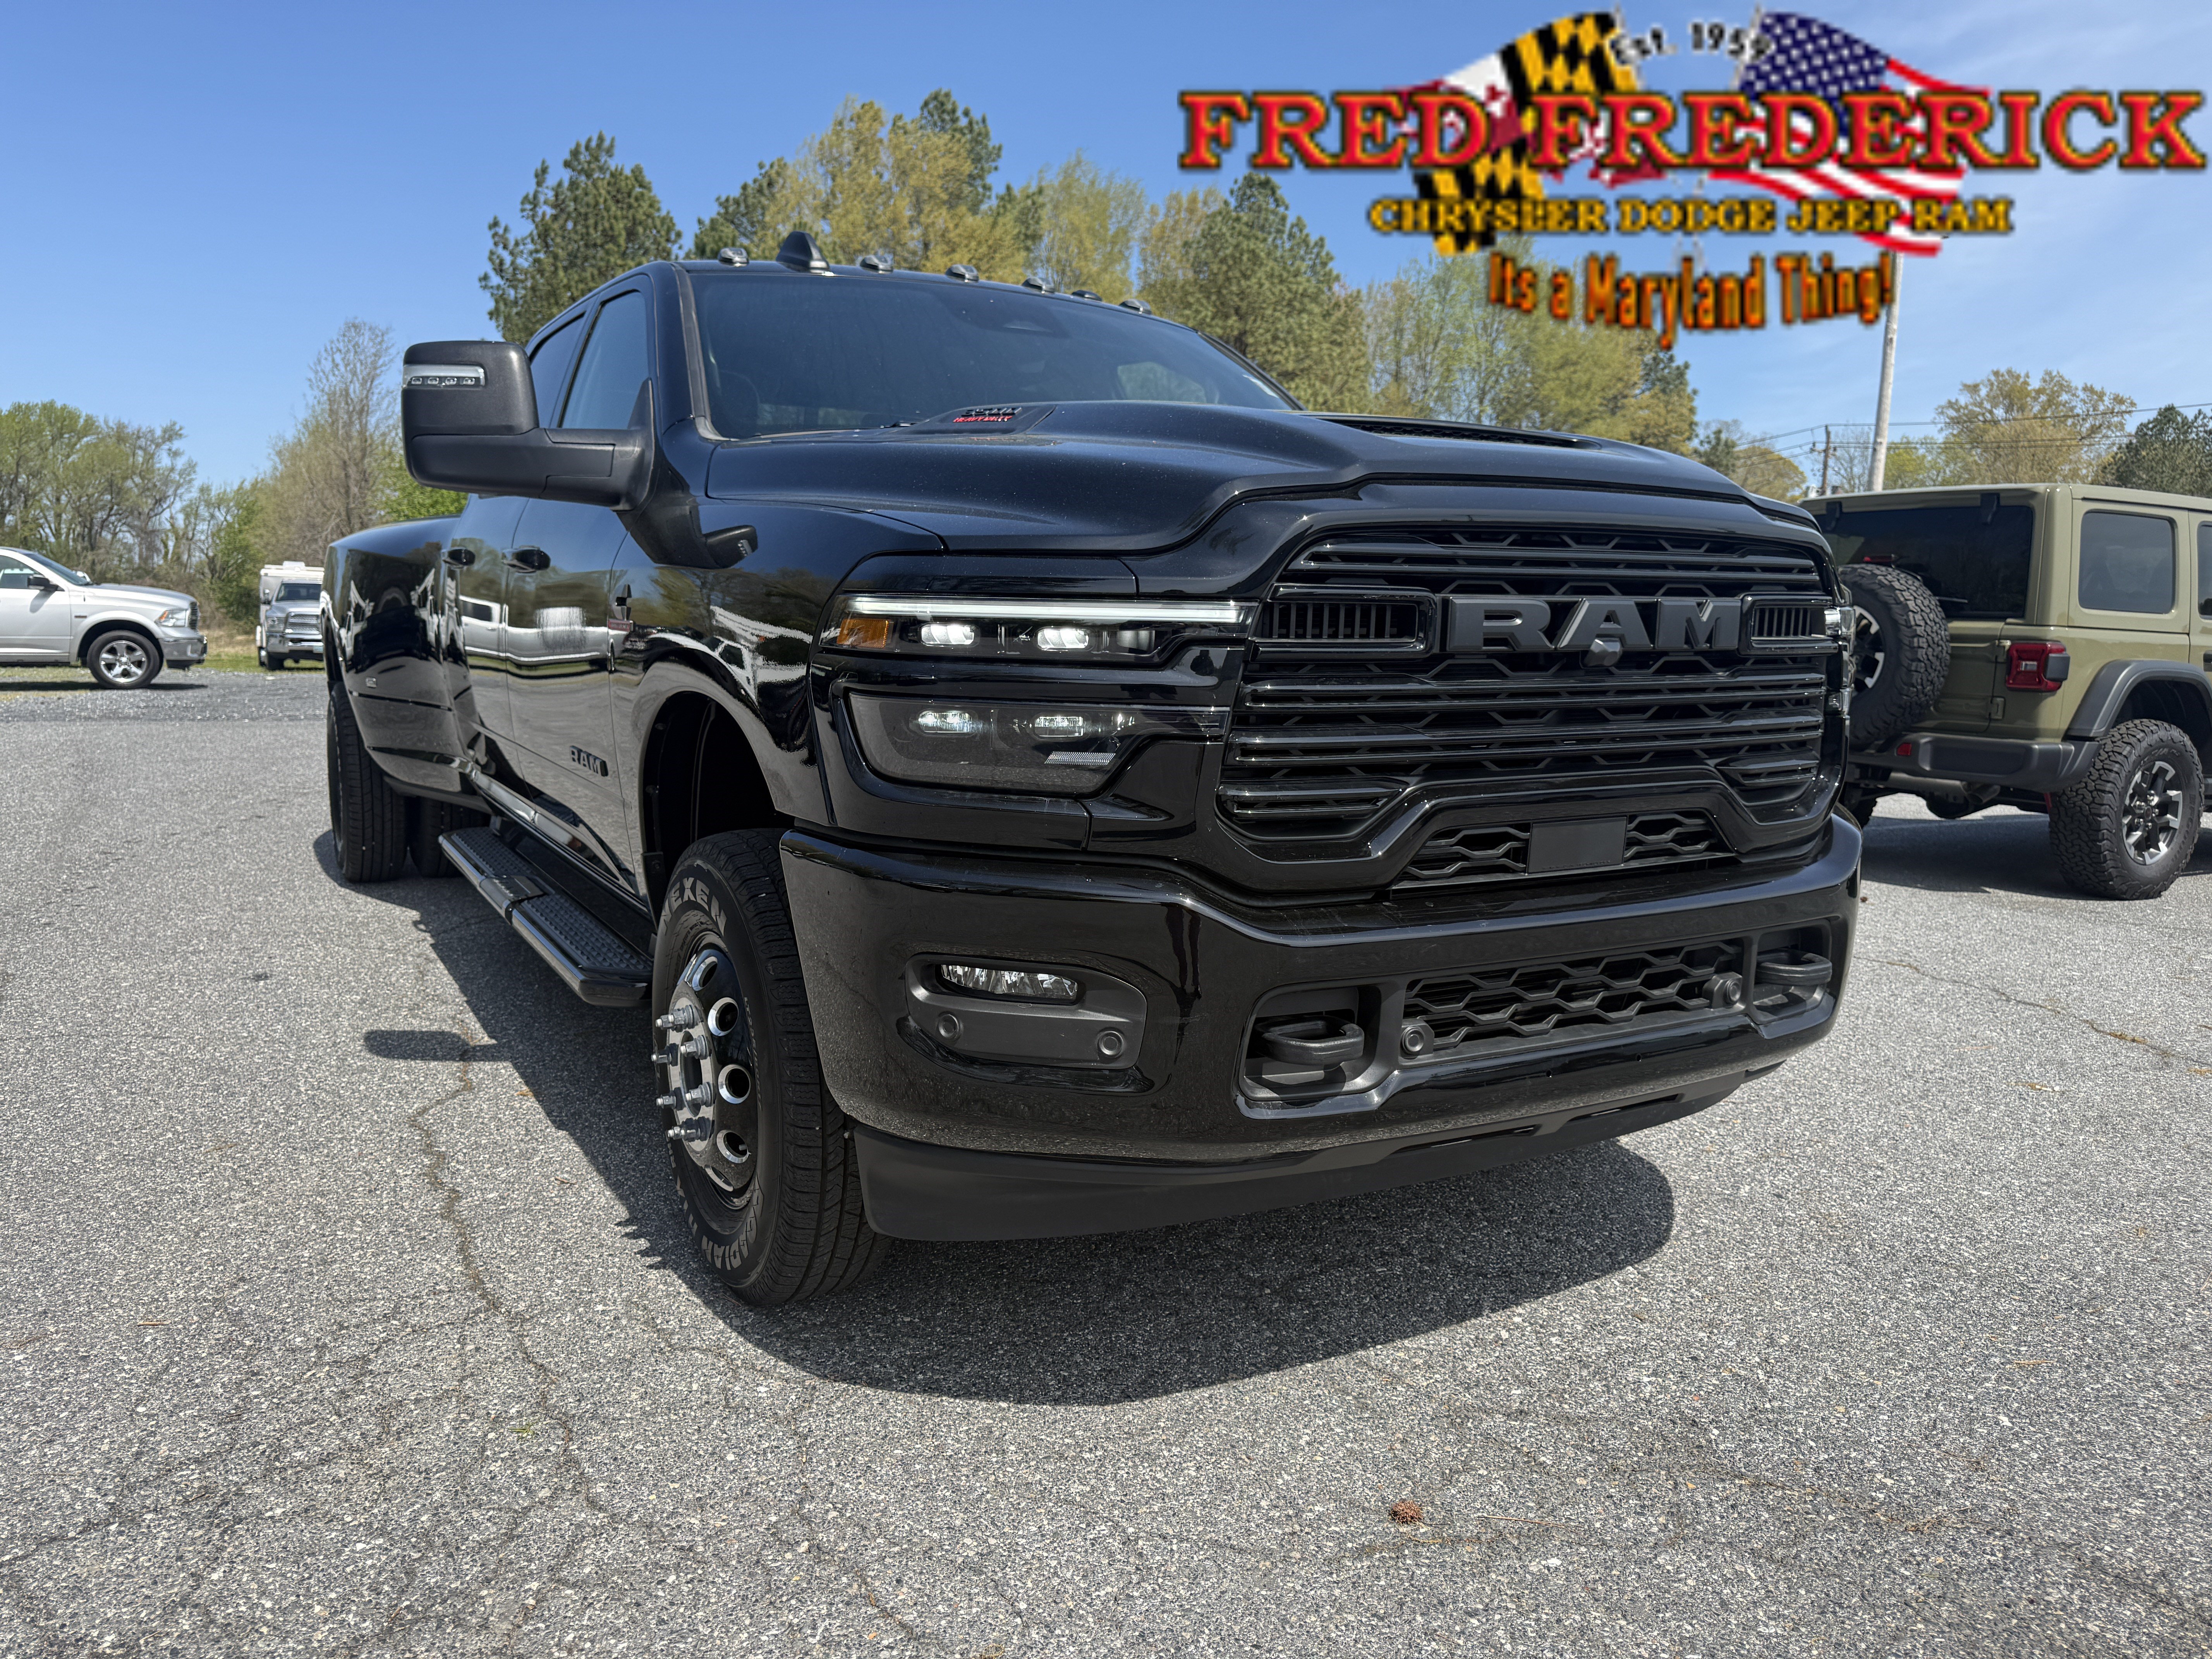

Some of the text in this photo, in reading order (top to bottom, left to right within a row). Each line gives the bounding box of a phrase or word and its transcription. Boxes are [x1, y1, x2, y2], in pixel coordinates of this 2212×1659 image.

[1449, 597, 1741, 652] RAM
[569, 745, 608, 777] RAM
[658, 877, 727, 936] NEXEN
